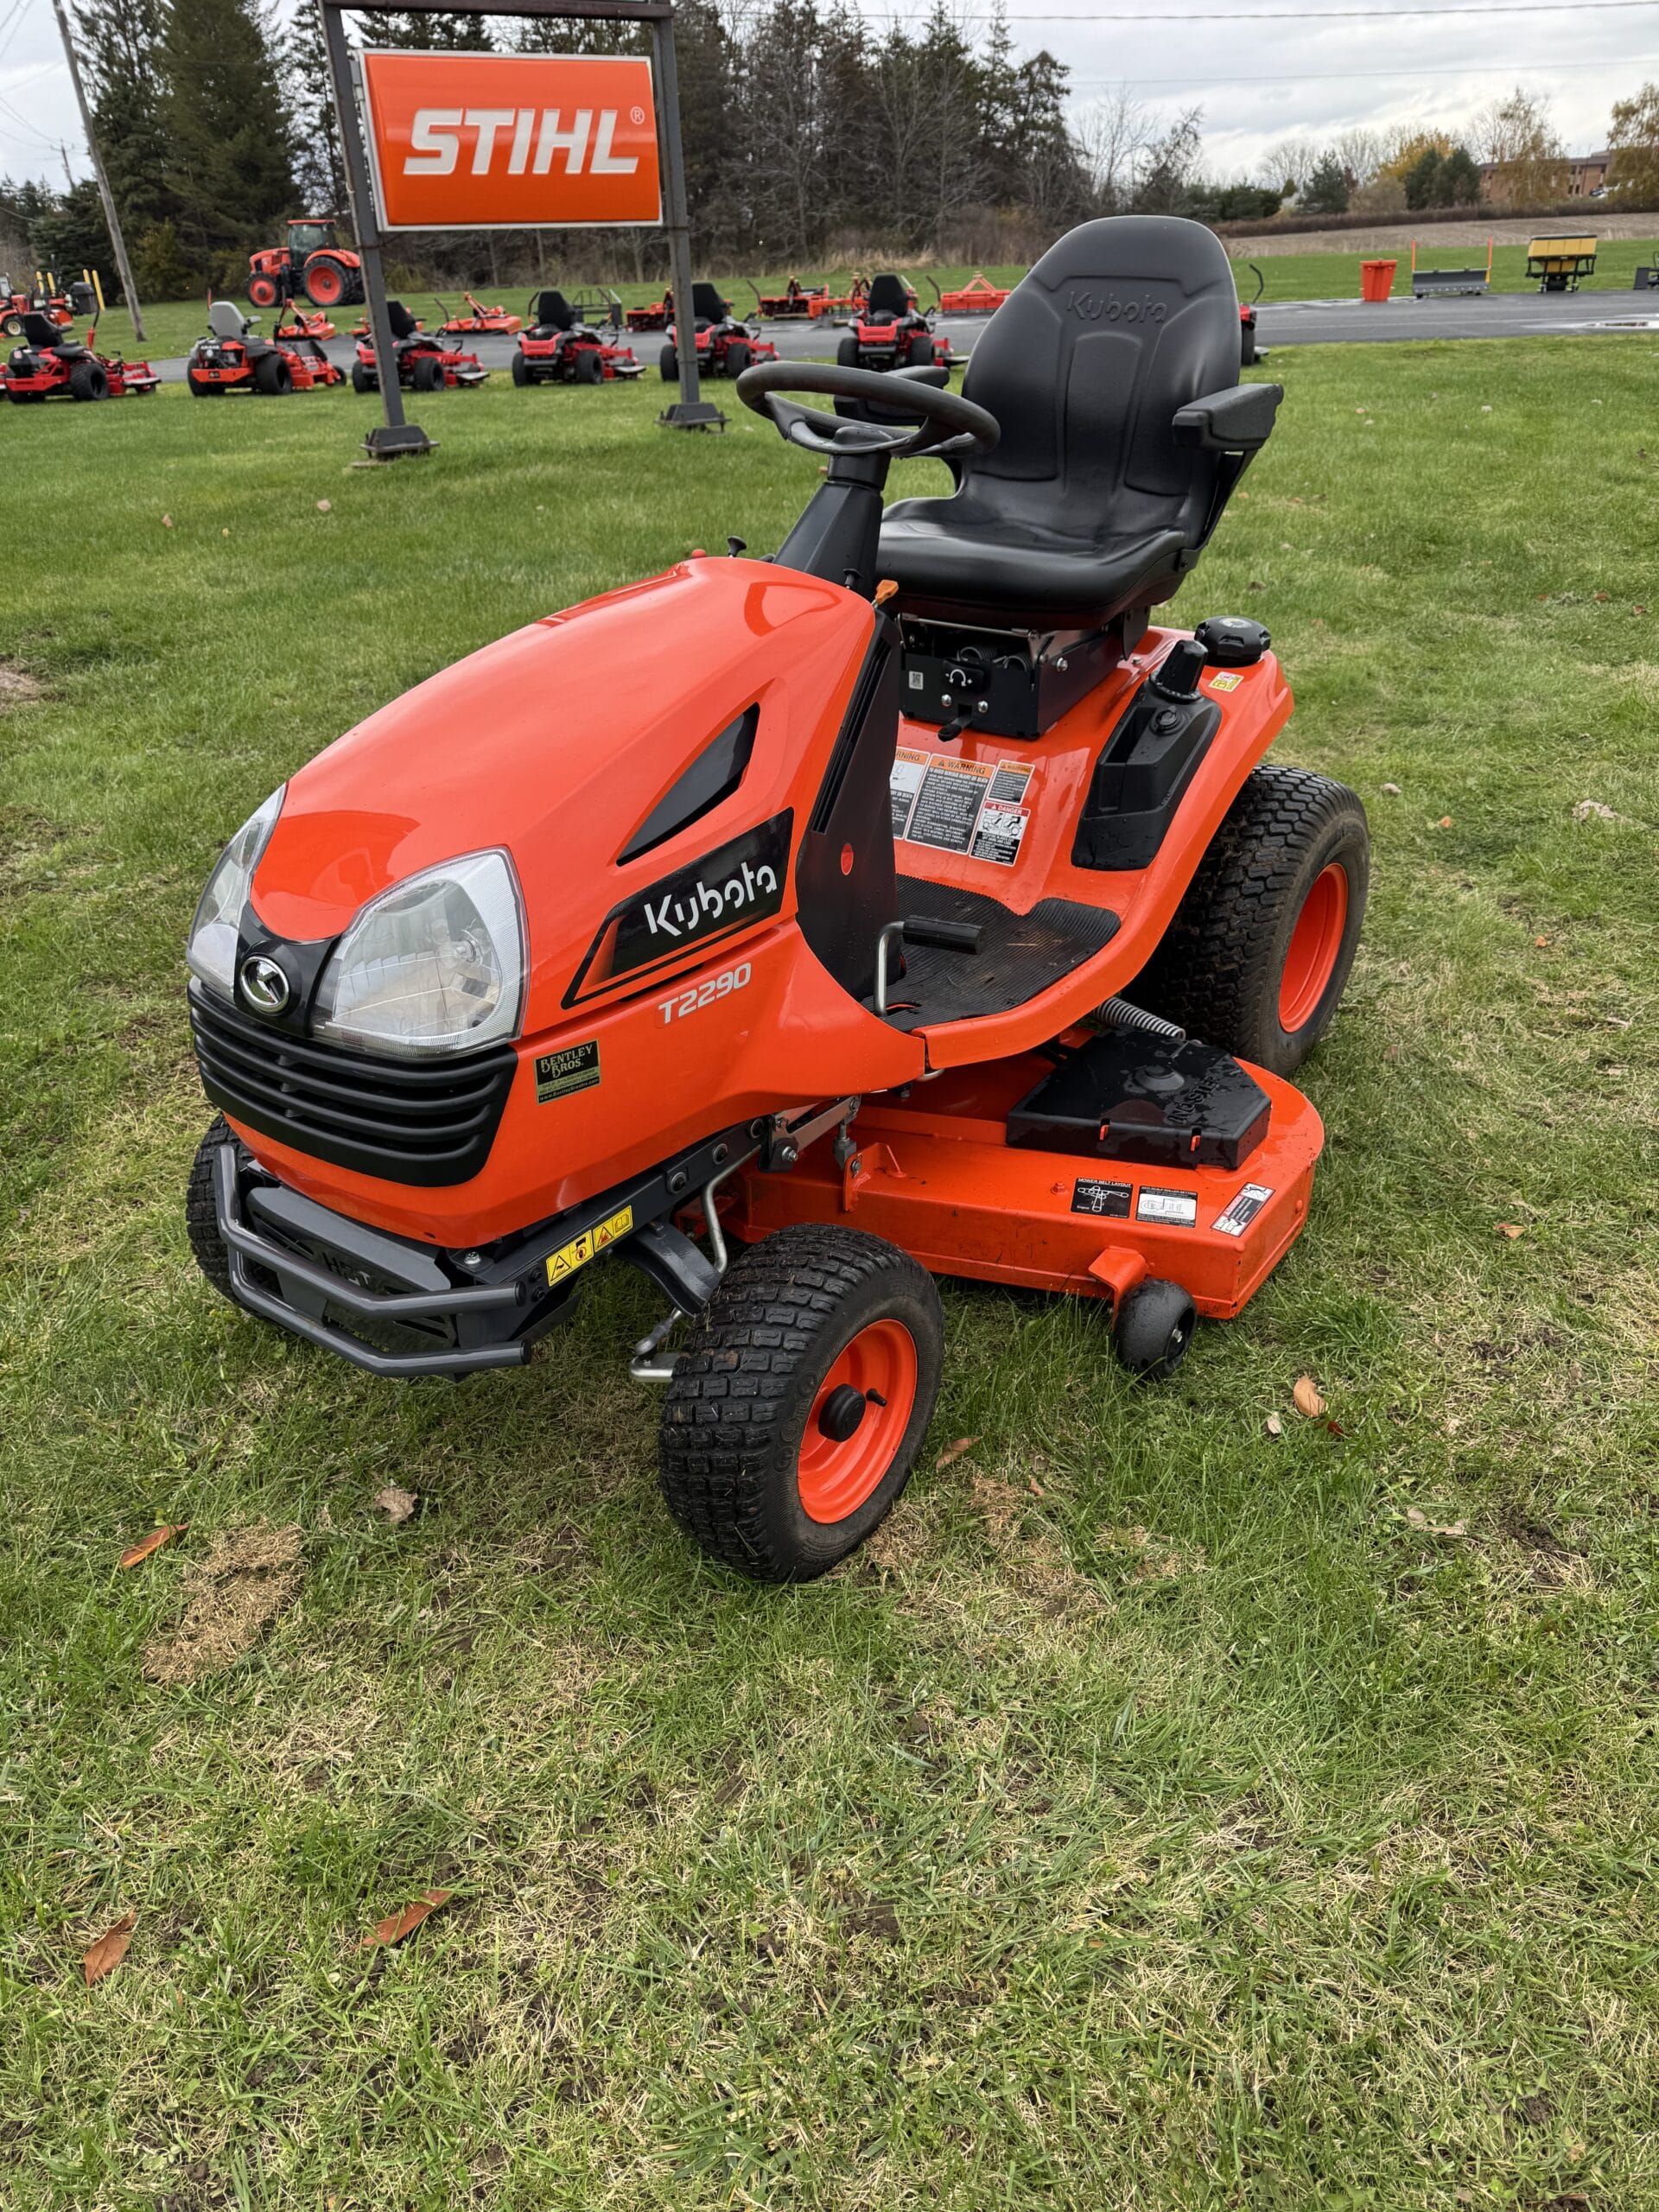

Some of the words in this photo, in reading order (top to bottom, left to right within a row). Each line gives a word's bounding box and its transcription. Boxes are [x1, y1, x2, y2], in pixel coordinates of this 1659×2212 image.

[403, 107, 639, 175] STIHL
[1067, 291, 1167, 323] Kubota
[896, 750, 920, 762] RNING
[948, 762, 986, 775] WARNING
[998, 804, 1023, 815] DANGER
[644, 861, 777, 937] Kubota
[658, 963, 752, 1024] T2290
[540, 1044, 593, 1072] BENTLEY
[551, 1058, 584, 1077] BROS.
